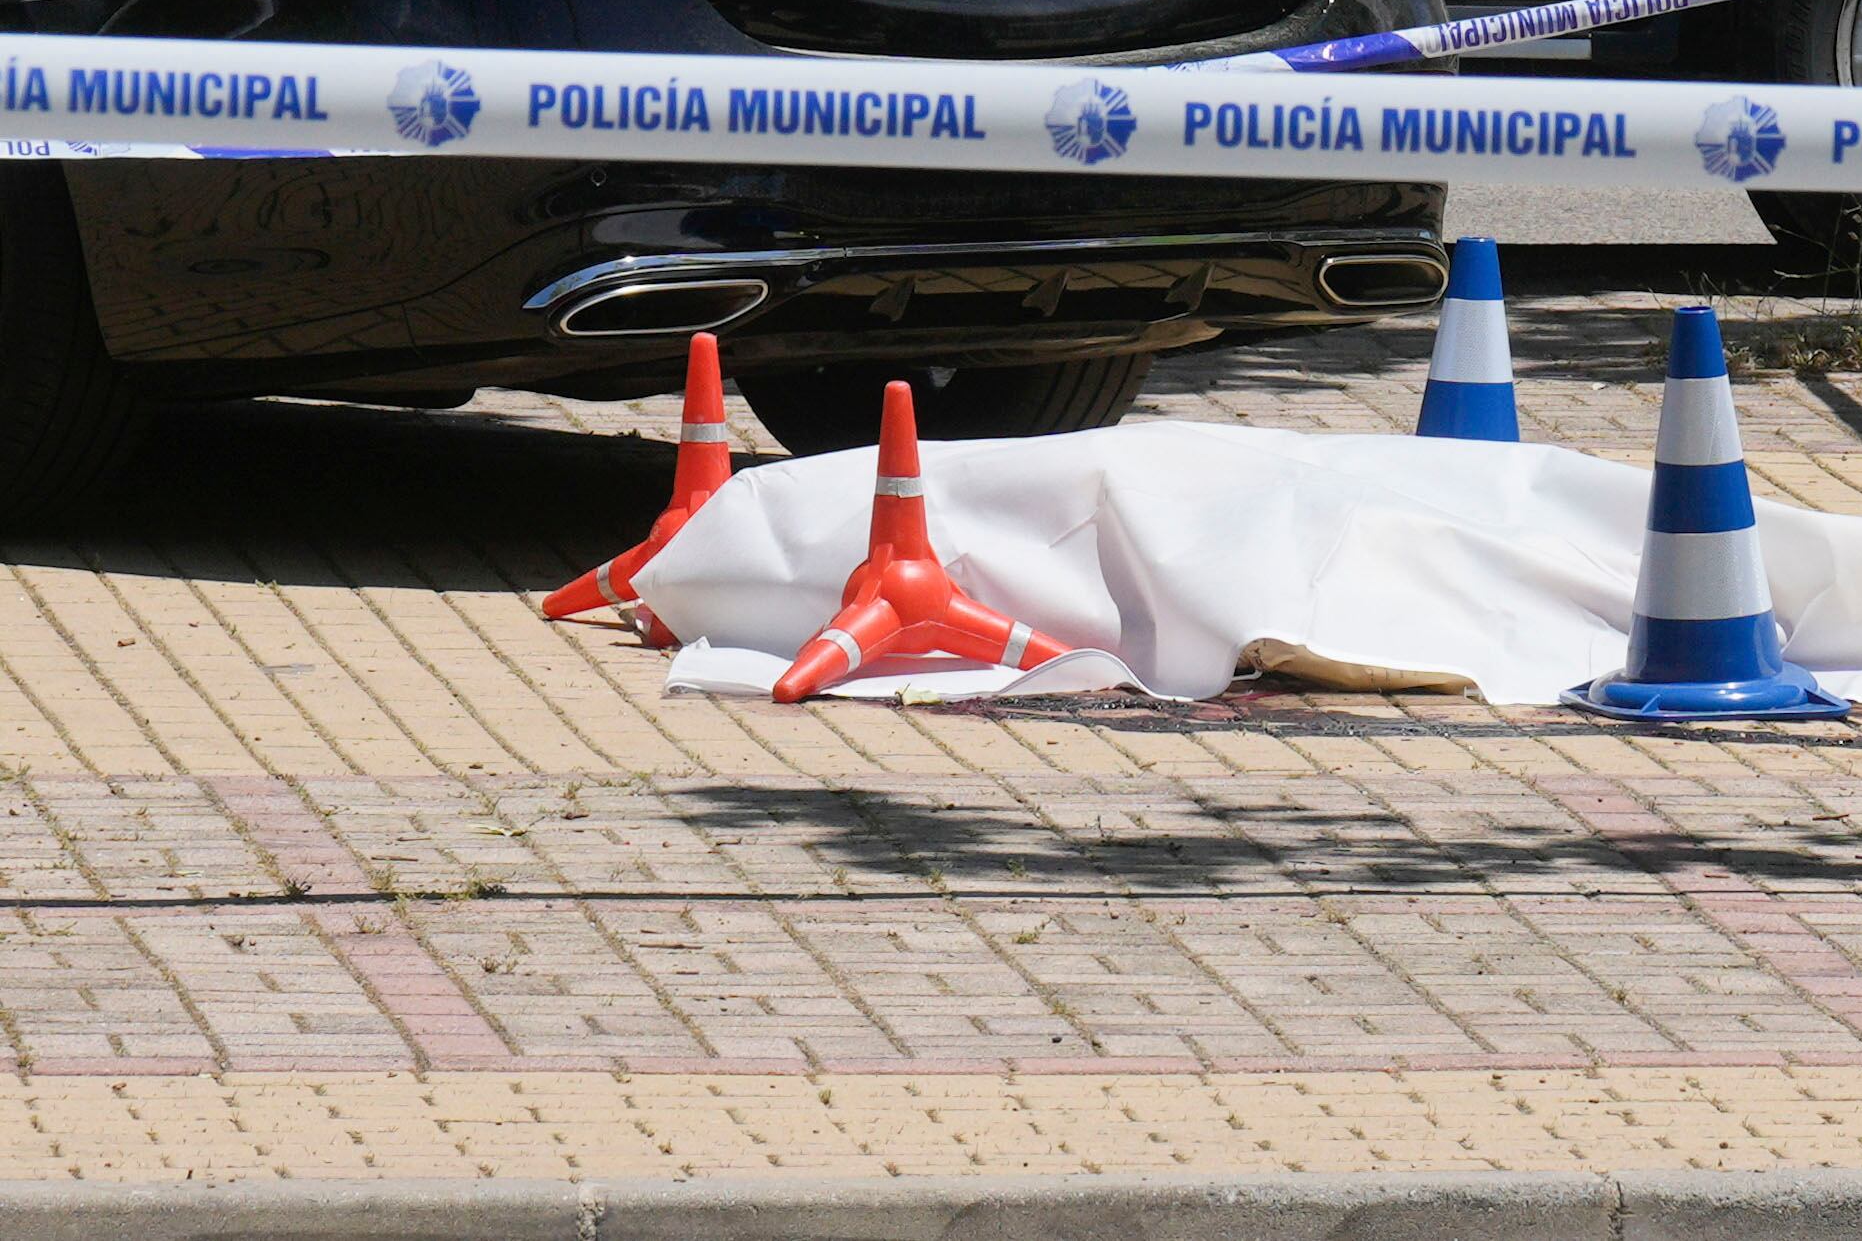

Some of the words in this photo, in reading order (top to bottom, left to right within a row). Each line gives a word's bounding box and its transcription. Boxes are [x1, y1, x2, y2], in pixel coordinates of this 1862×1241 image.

[69, 70, 328, 121] MUNICIPAL
[528, 77, 711, 134] POLICÍA
[728, 88, 986, 140] MUNICIPAL
[1183, 95, 1364, 151] POLICÍA
[1381, 108, 1635, 159] MUNICIPAL
